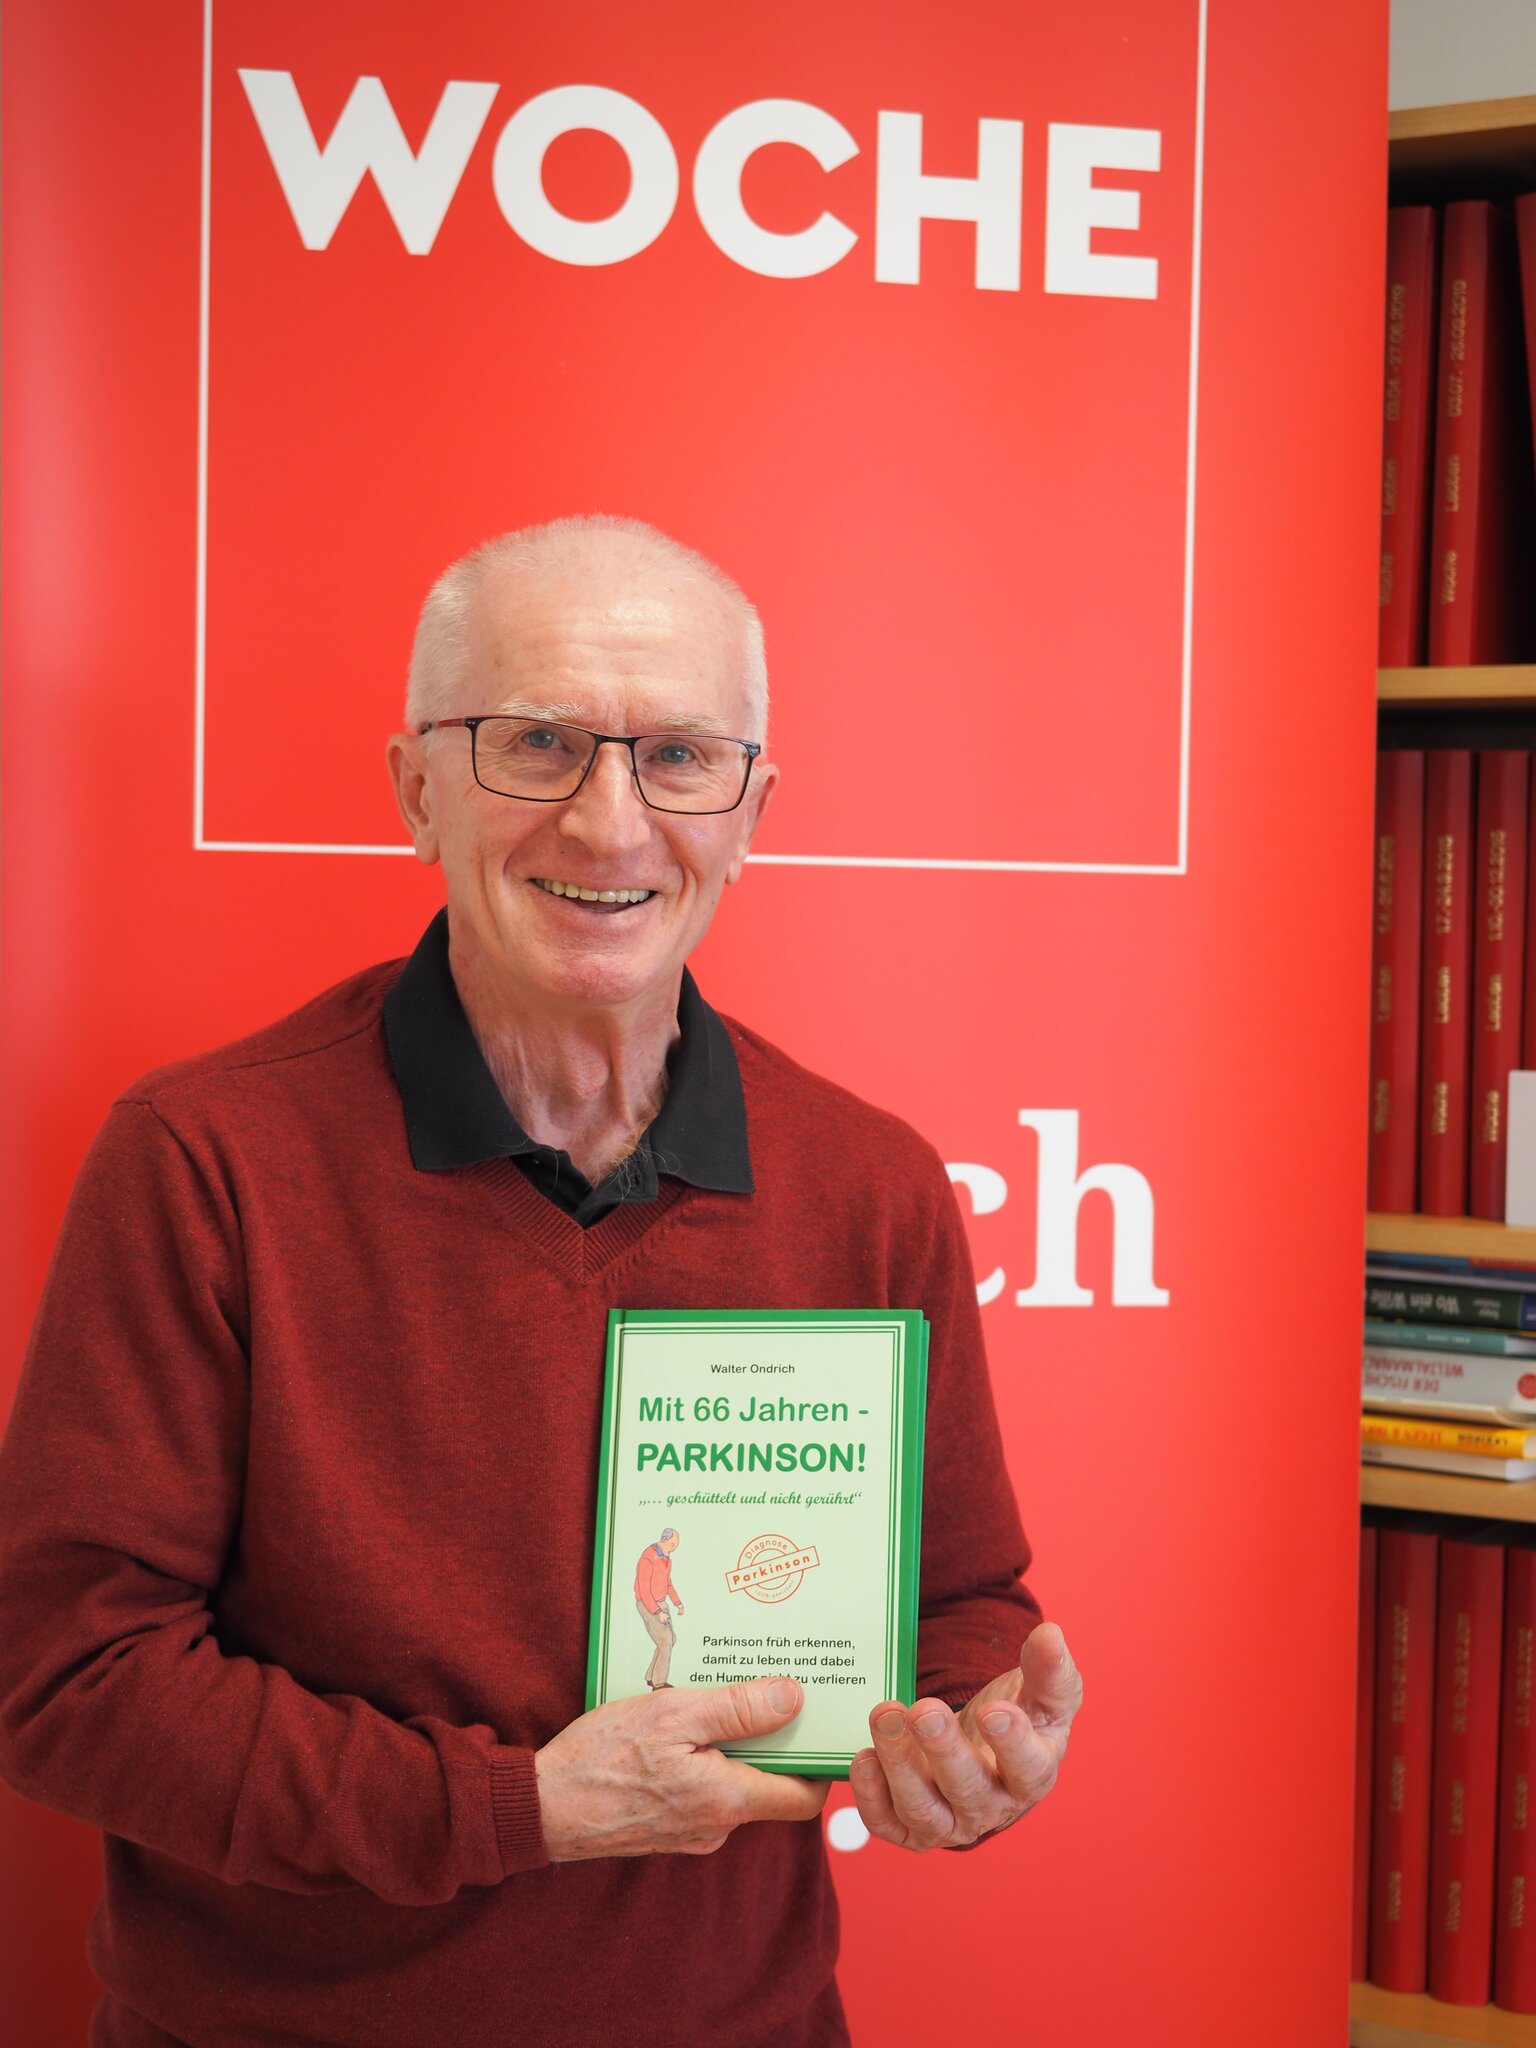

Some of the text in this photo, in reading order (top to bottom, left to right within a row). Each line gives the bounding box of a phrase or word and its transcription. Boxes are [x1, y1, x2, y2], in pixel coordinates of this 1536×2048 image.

[239, 69, 1162, 300] WOCHE
[1441, 549, 1458, 604] Woche
[711, 1364, 795, 1374] Walter Ondrich
[639, 1397, 684, 1422] Mit
[694, 1397, 730, 1422] 66
[739, 1397, 848, 1422] Jahren
[637, 1442, 866, 1472] PARKINSON!
[667, 1491, 736, 1508] geschüttelt
[740, 1491, 766, 1505] und
[770, 1491, 801, 1505] nicht
[745, 1540, 788, 1559] Diagnose
[733, 1555, 811, 1585] Parkinson
[703, 1636, 856, 1649] Parkinson früh erkennen,
[703, 1654, 855, 1667] damit zu leben und dabei
[690, 1672, 712, 1682] den
[717, 1673, 758, 1683] Humor
[795, 1676, 809, 1684] zu
[812, 1674, 866, 1685] verlieren
